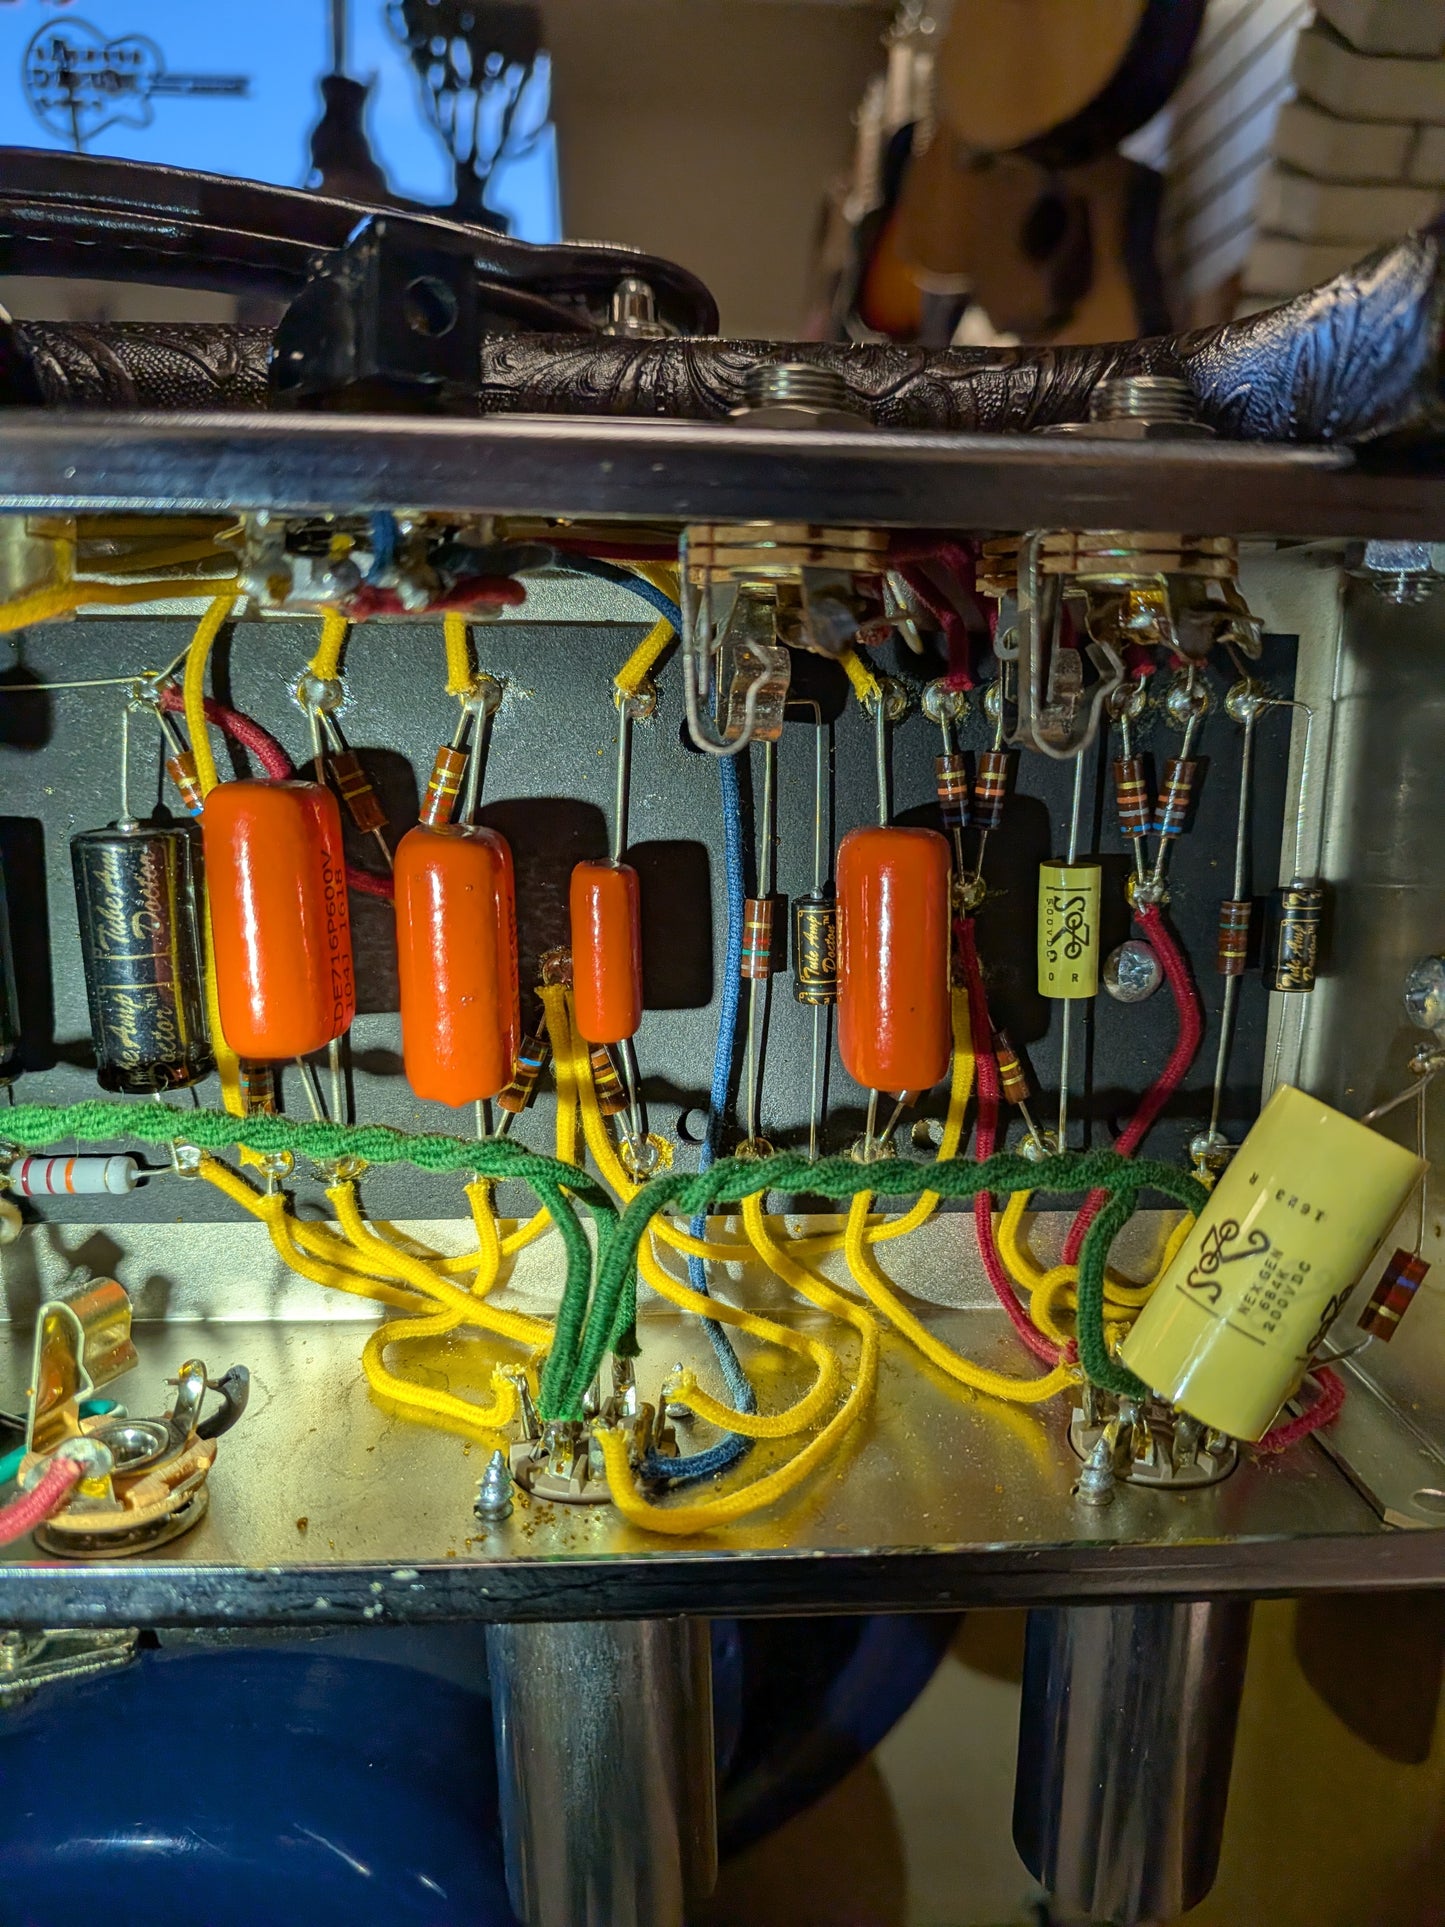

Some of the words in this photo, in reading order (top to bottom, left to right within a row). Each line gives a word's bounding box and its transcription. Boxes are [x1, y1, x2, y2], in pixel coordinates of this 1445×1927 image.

[803, 915, 823, 948] Amp
[822, 925, 836, 973] Doctor
[106, 993, 145, 1049] Amp
[1262, 1260, 1311, 1333] 200VDC
